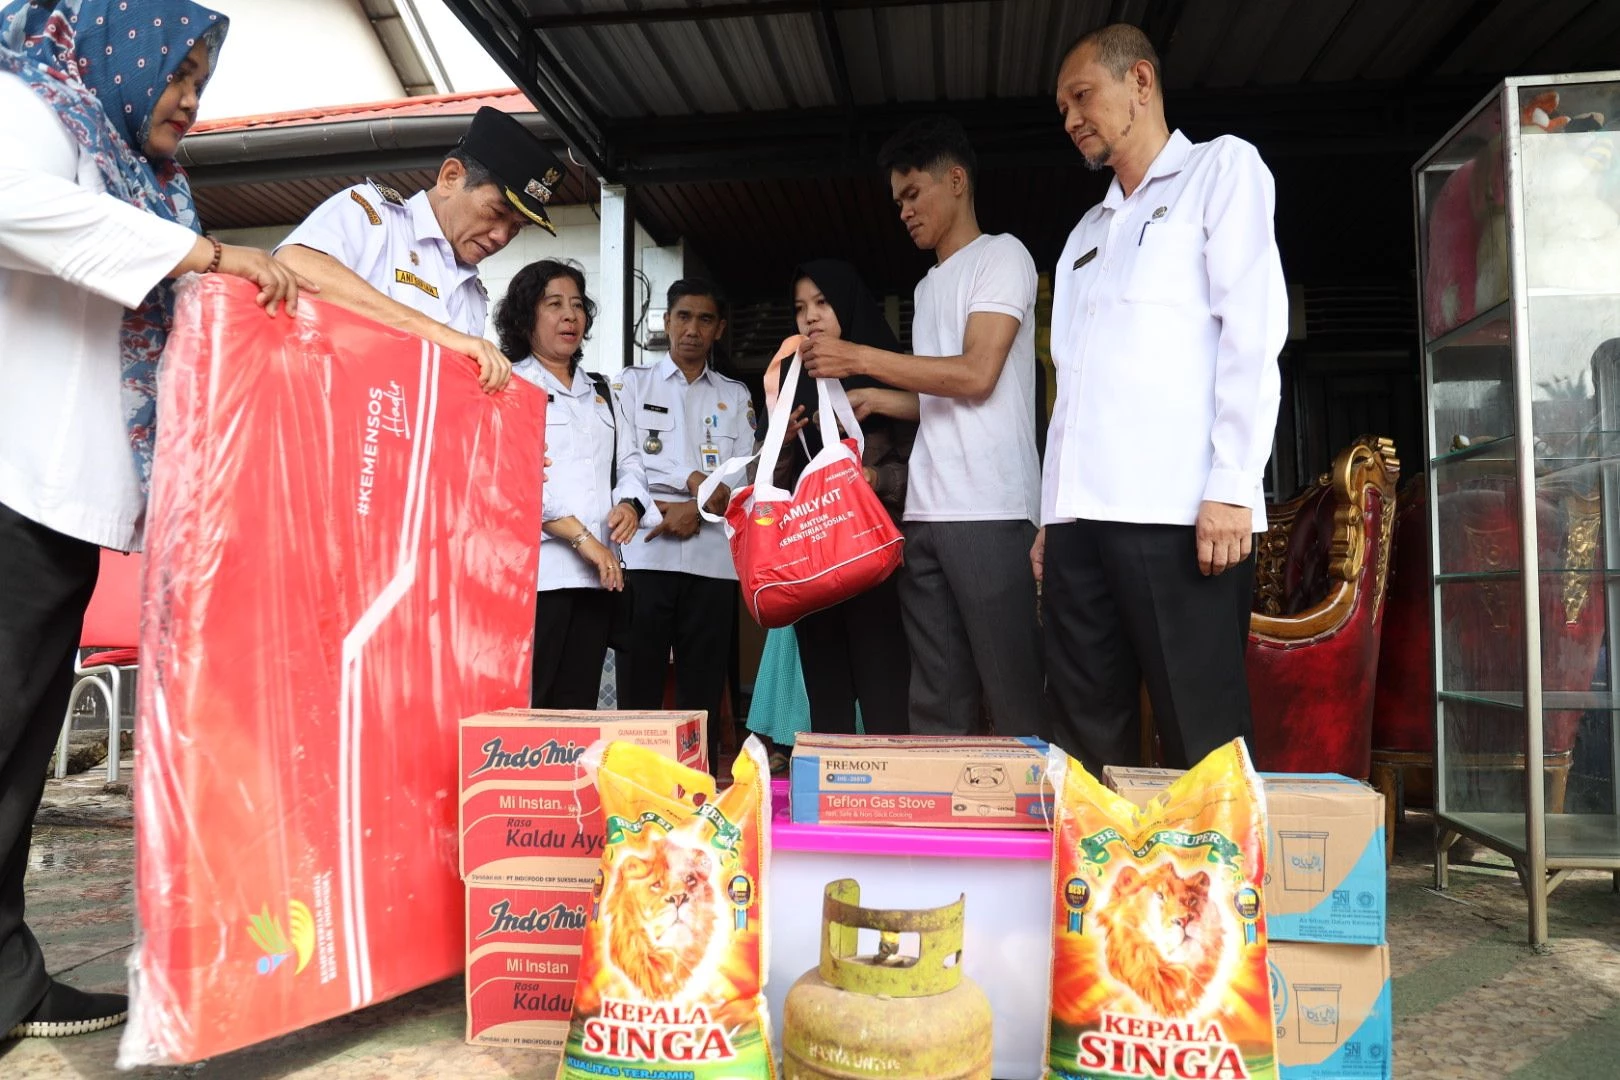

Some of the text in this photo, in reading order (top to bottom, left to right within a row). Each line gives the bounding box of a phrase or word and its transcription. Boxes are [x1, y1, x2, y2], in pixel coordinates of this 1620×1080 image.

[357, 387, 383, 516] #KEMENSOS
[821, 488, 841, 507] KIT
[826, 760, 889, 771] FREMONT
[499, 795, 516, 809] Mi
[518, 796, 561, 809] Instan
[826, 795, 936, 809] Teflon Gas Stove
[507, 818, 532, 828] Rasa
[506, 829, 566, 848] Kaldu
[1174, 831, 1223, 847] SUPER
[506, 957, 569, 974] Mi Instan
[513, 982, 540, 992] Rasa
[513, 993, 573, 1013] Kaldu
[603, 1000, 709, 1025] KEPALA
[1105, 1014, 1223, 1043] KEPALA
[584, 1021, 735, 1061] SINGA
[1079, 1035, 1247, 1080] SINGA
[567, 1056, 621, 1077] KUALITAS
[622, 1067, 695, 1080] TERJAMIN
